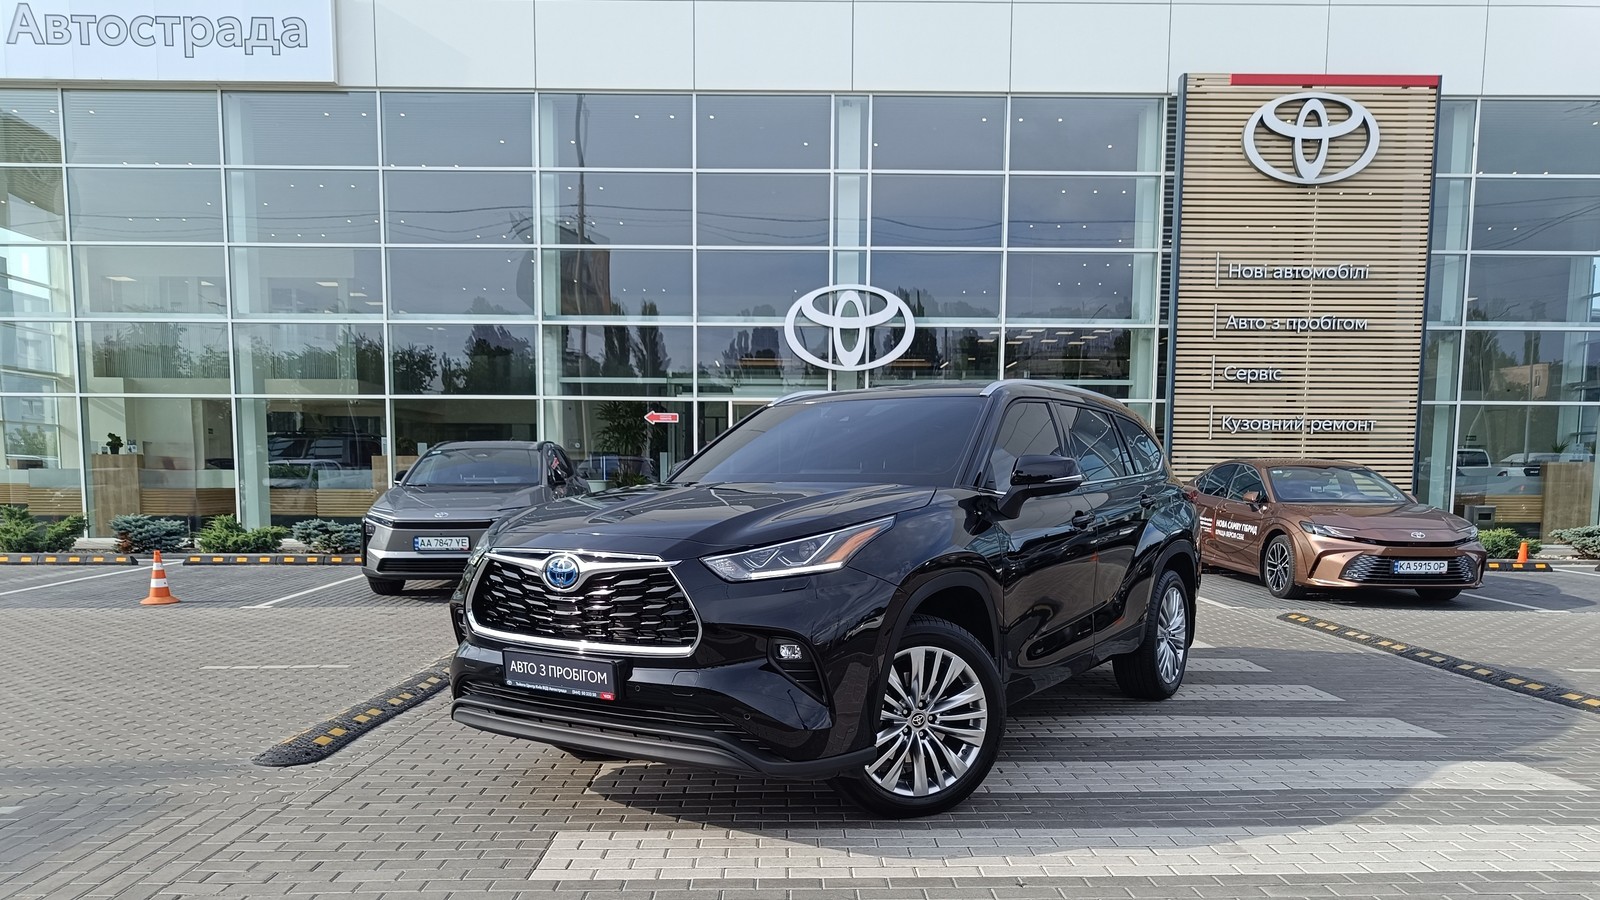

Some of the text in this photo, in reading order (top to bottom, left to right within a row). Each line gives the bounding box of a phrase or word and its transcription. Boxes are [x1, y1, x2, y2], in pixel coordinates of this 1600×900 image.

[6, 2, 309, 58] Автострада
[1228, 263, 1370, 280] Нові автомобілі
[1225, 314, 1368, 334] Авто з пробігом
[1223, 365, 1283, 384] Сервіс
[1221, 415, 1377, 435] Кузовний ремонт
[420, 538, 467, 547] AA 7847 YE
[1399, 562, 1411, 571] KA
[1413, 562, 1432, 571] 5915
[510, 660, 537, 675] АВТО
[548, 665, 608, 685] ПРОБІГОМ
